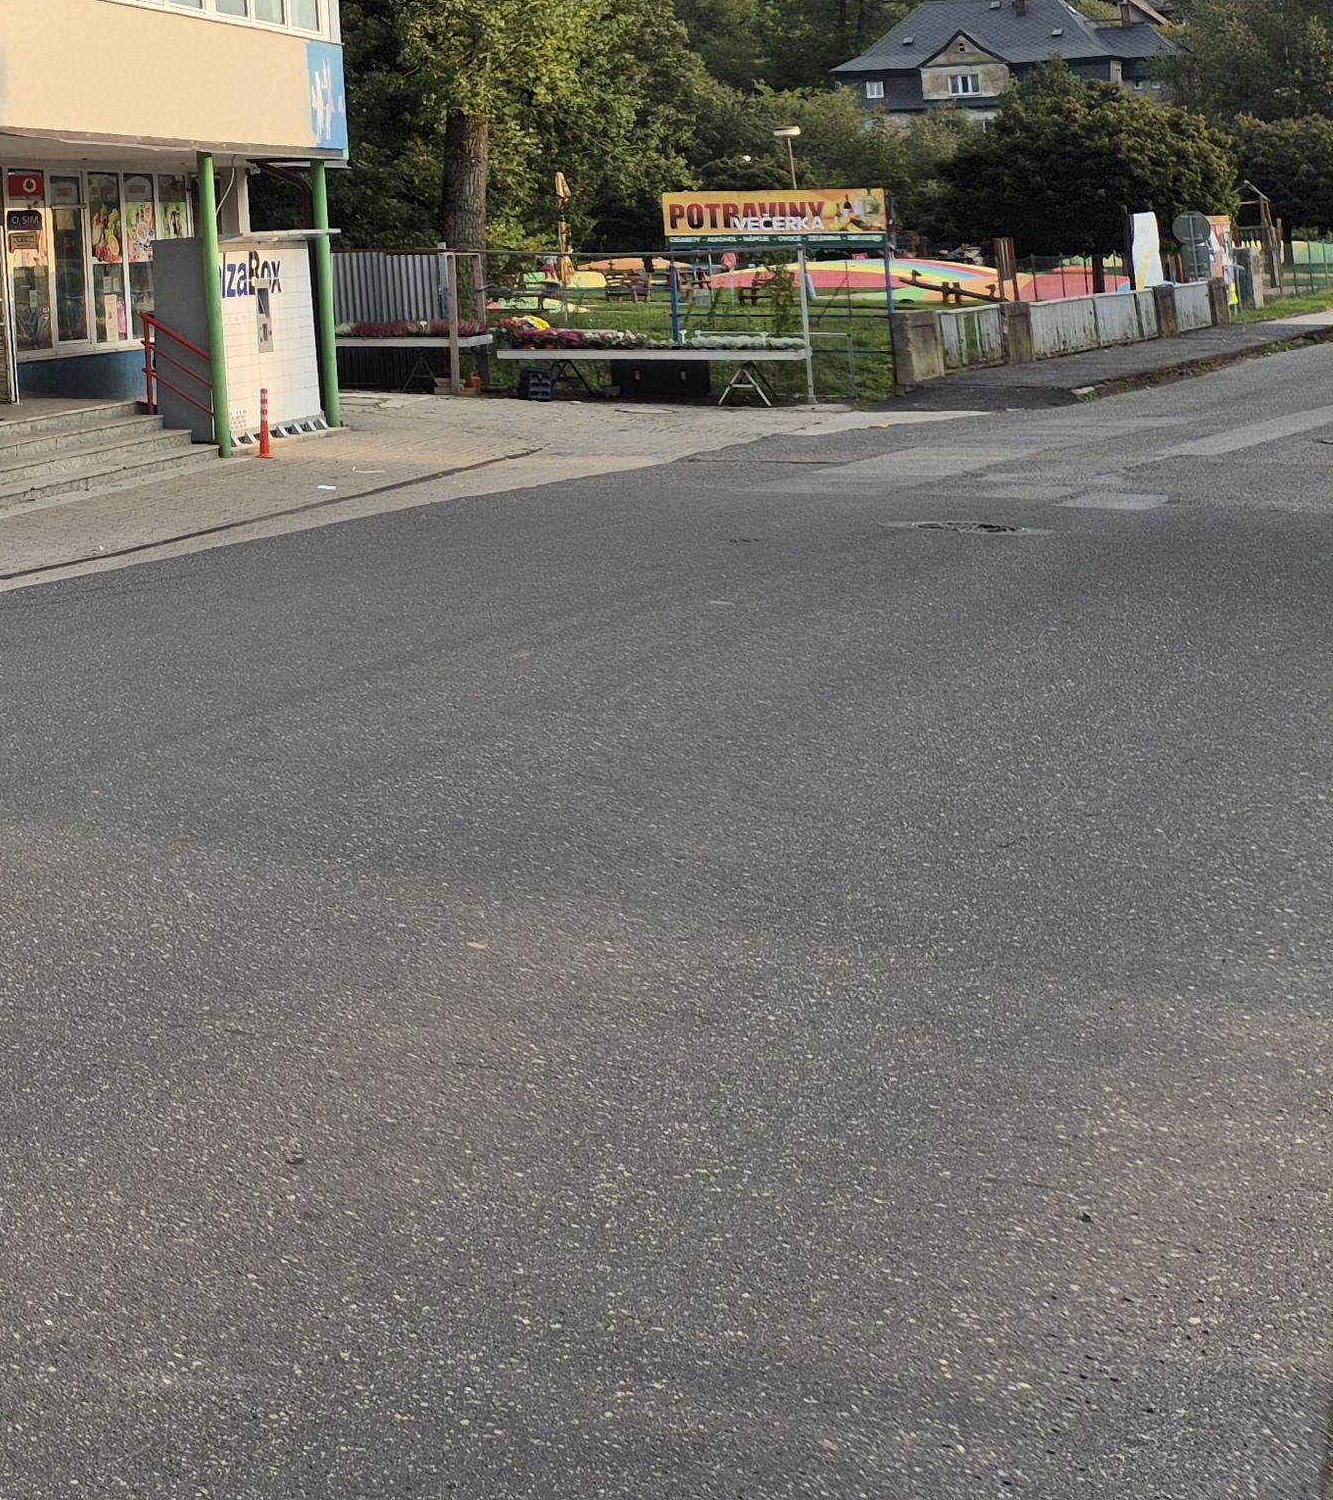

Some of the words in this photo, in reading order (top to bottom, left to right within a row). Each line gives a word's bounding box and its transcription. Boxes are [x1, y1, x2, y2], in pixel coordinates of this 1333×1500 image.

[669, 201, 825, 229] POTRAVINY
[732, 213, 824, 231] VEČERKA
[219, 251, 282, 298] lzaBox
